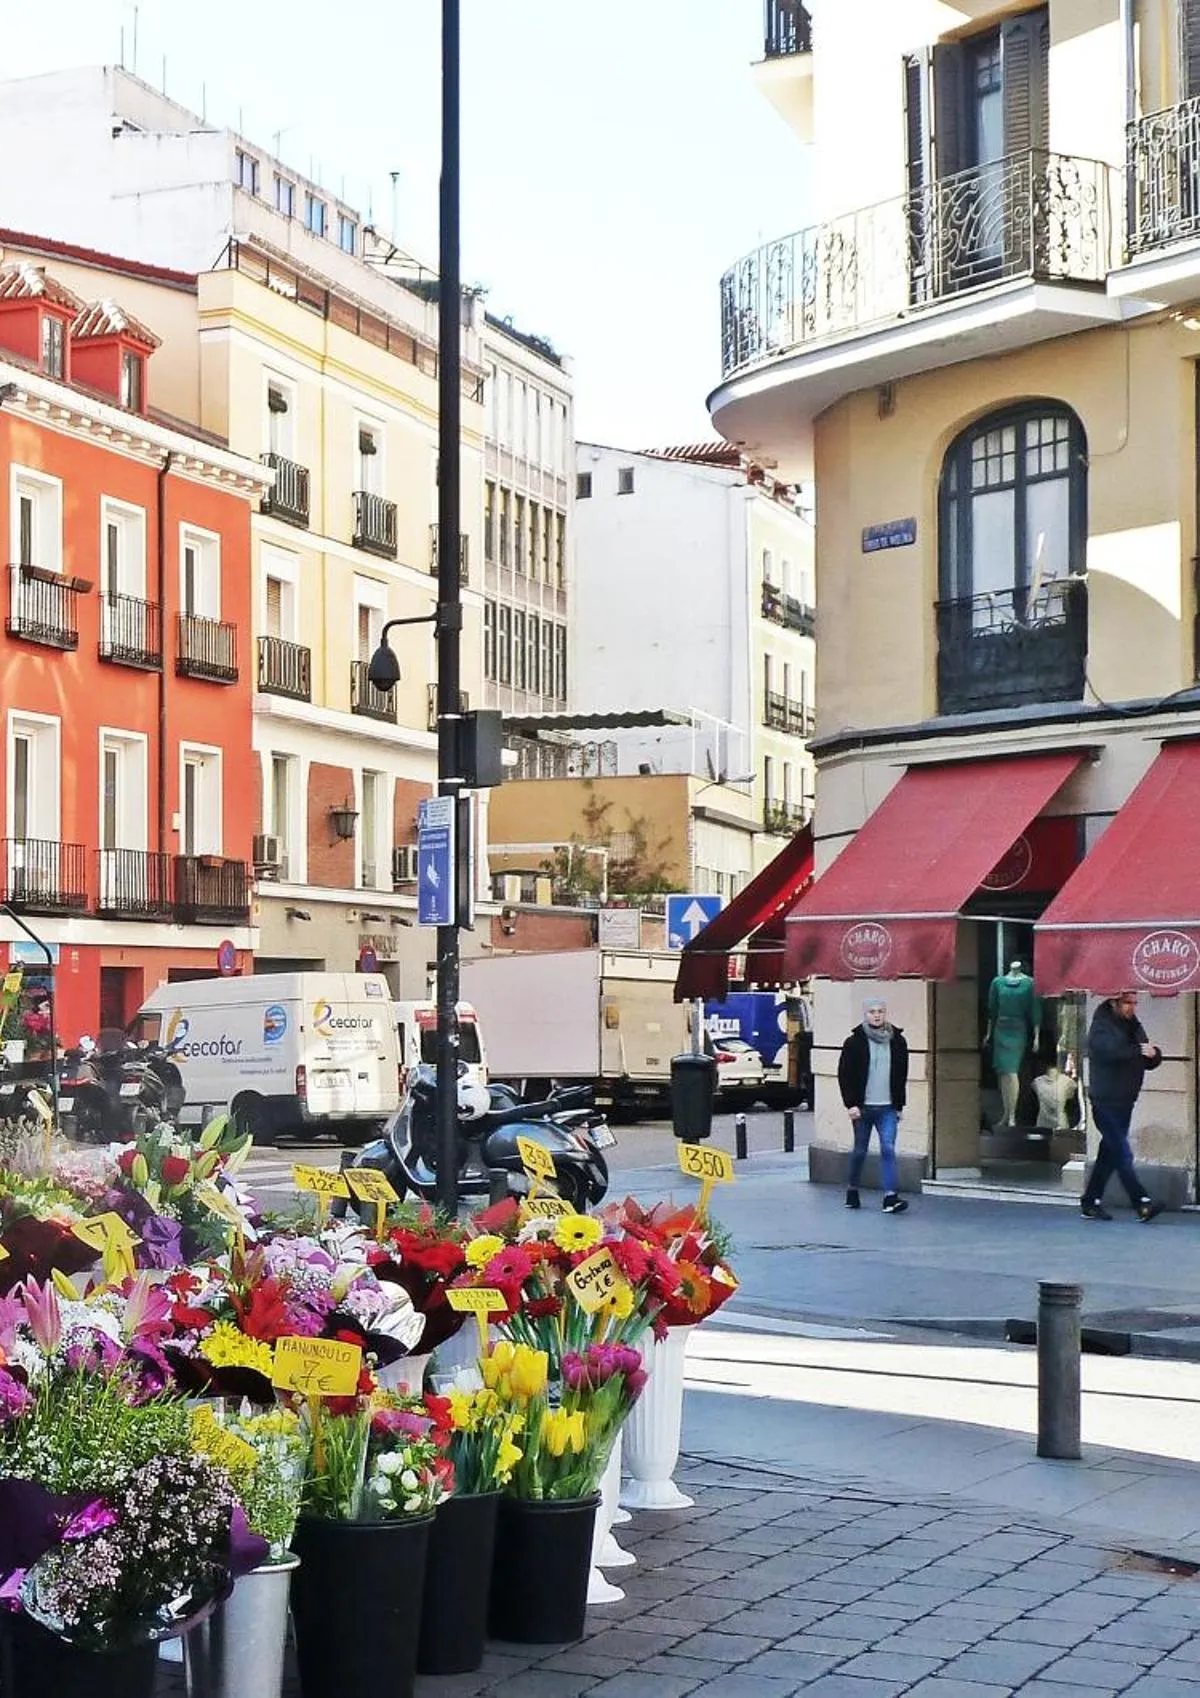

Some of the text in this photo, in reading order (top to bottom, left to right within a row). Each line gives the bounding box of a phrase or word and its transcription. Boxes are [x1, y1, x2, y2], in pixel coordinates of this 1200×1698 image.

[1142, 938, 1190, 958] CHARO
[328, 1014, 374, 1029] cecofar
[182, 1034, 242, 1057] cecofar
[685, 1146, 725, 1178] 350
[527, 1201, 570, 1216] ROSA
